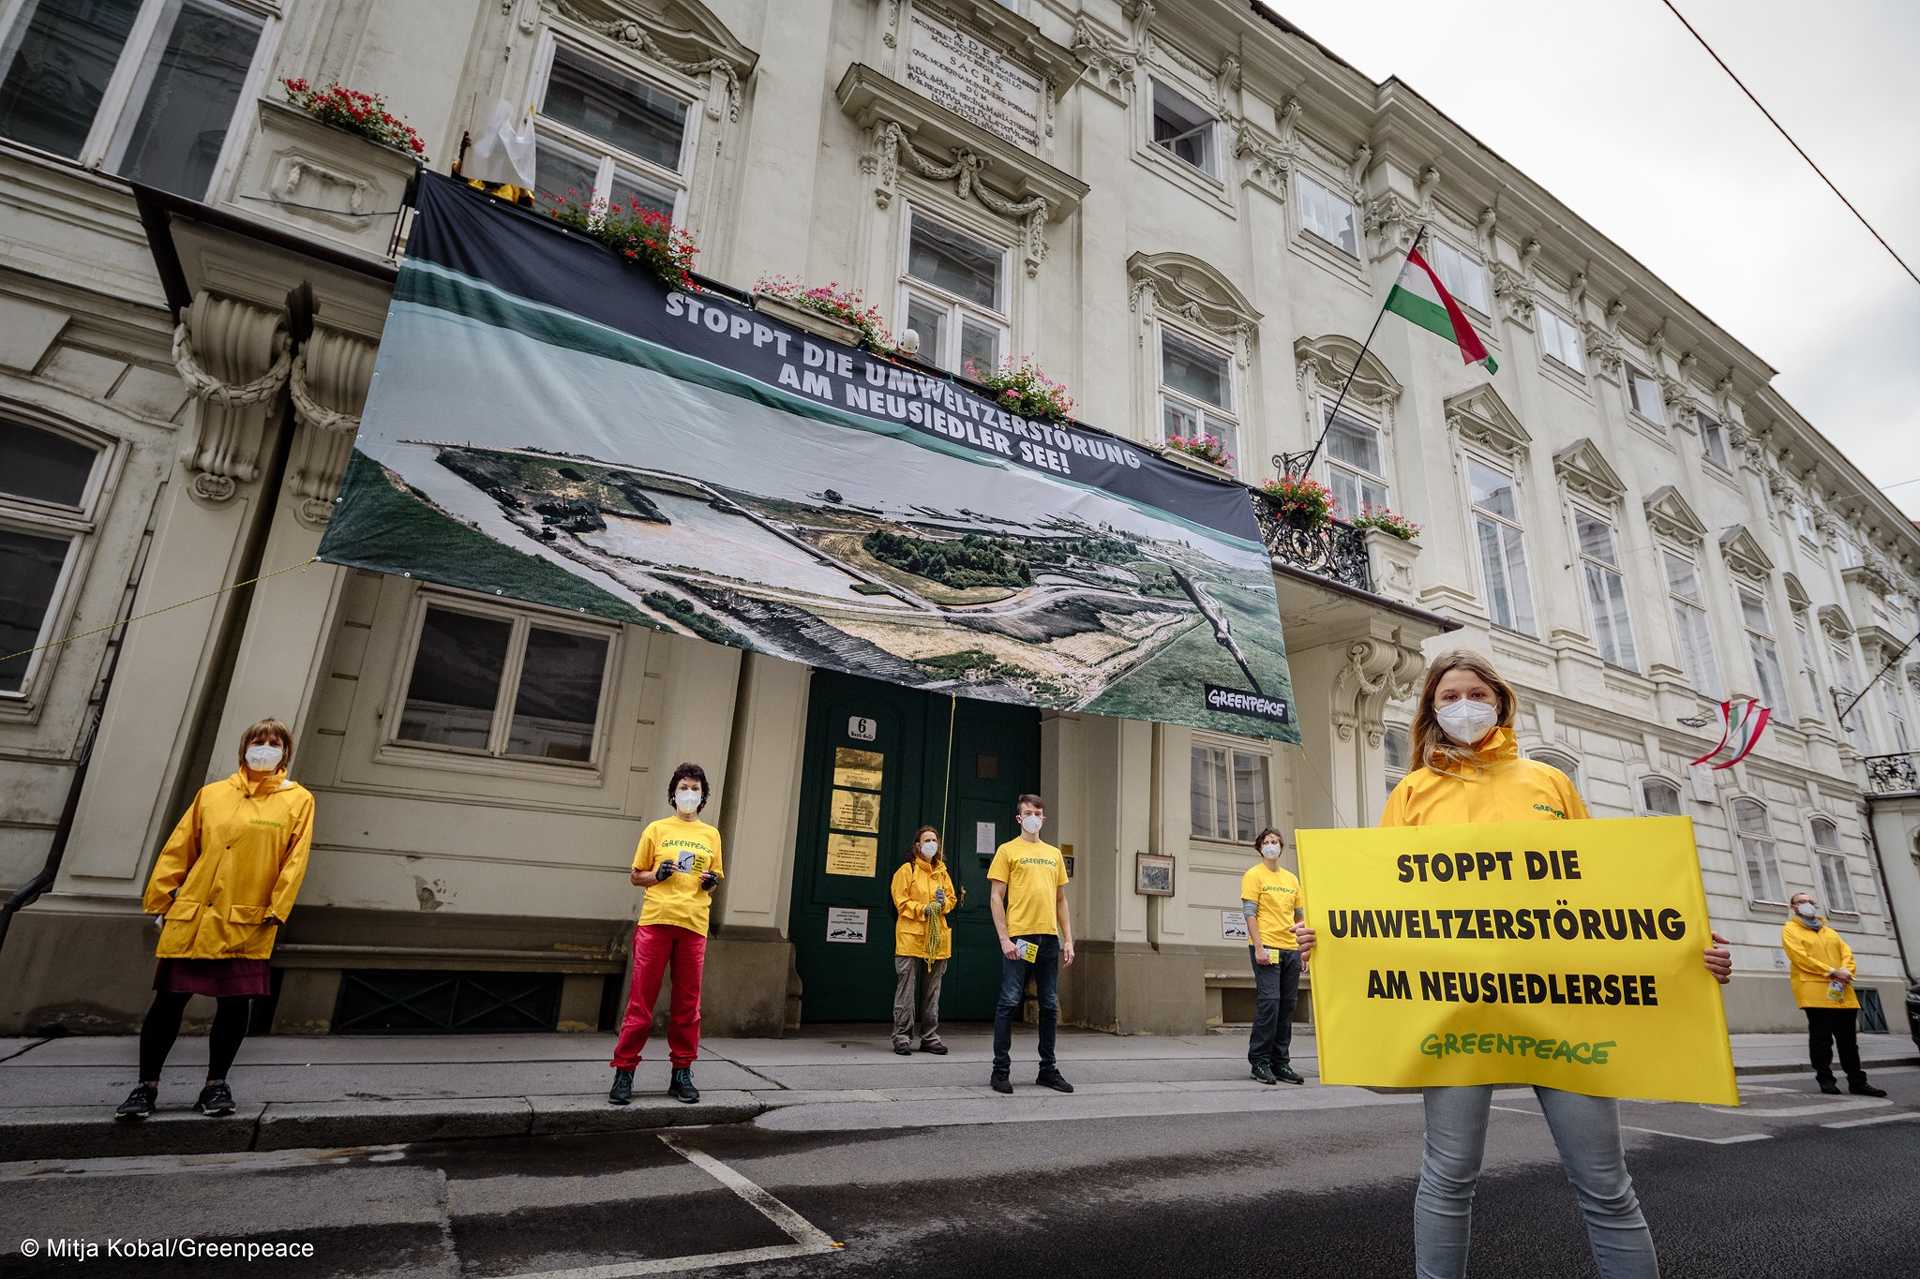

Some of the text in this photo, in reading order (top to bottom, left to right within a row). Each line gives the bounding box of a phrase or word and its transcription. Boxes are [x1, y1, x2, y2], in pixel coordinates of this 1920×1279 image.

[665, 292, 1142, 469] STOPPT DIE UMWELTZERSTÖRUNG
[778, 363, 1072, 475] AM NEUSIEDLER SEE!
[1208, 689, 1285, 717] GREENPEACE
[858, 718, 866, 733] 6
[1396, 849, 1582, 883] STOPPT DIE
[1328, 899, 1687, 941] UMWELTZERSTÖRUNG
[1367, 969, 1658, 1006] AM NEUSIEDLERSEE
[1420, 1033, 1617, 1065] GREENPEACE
